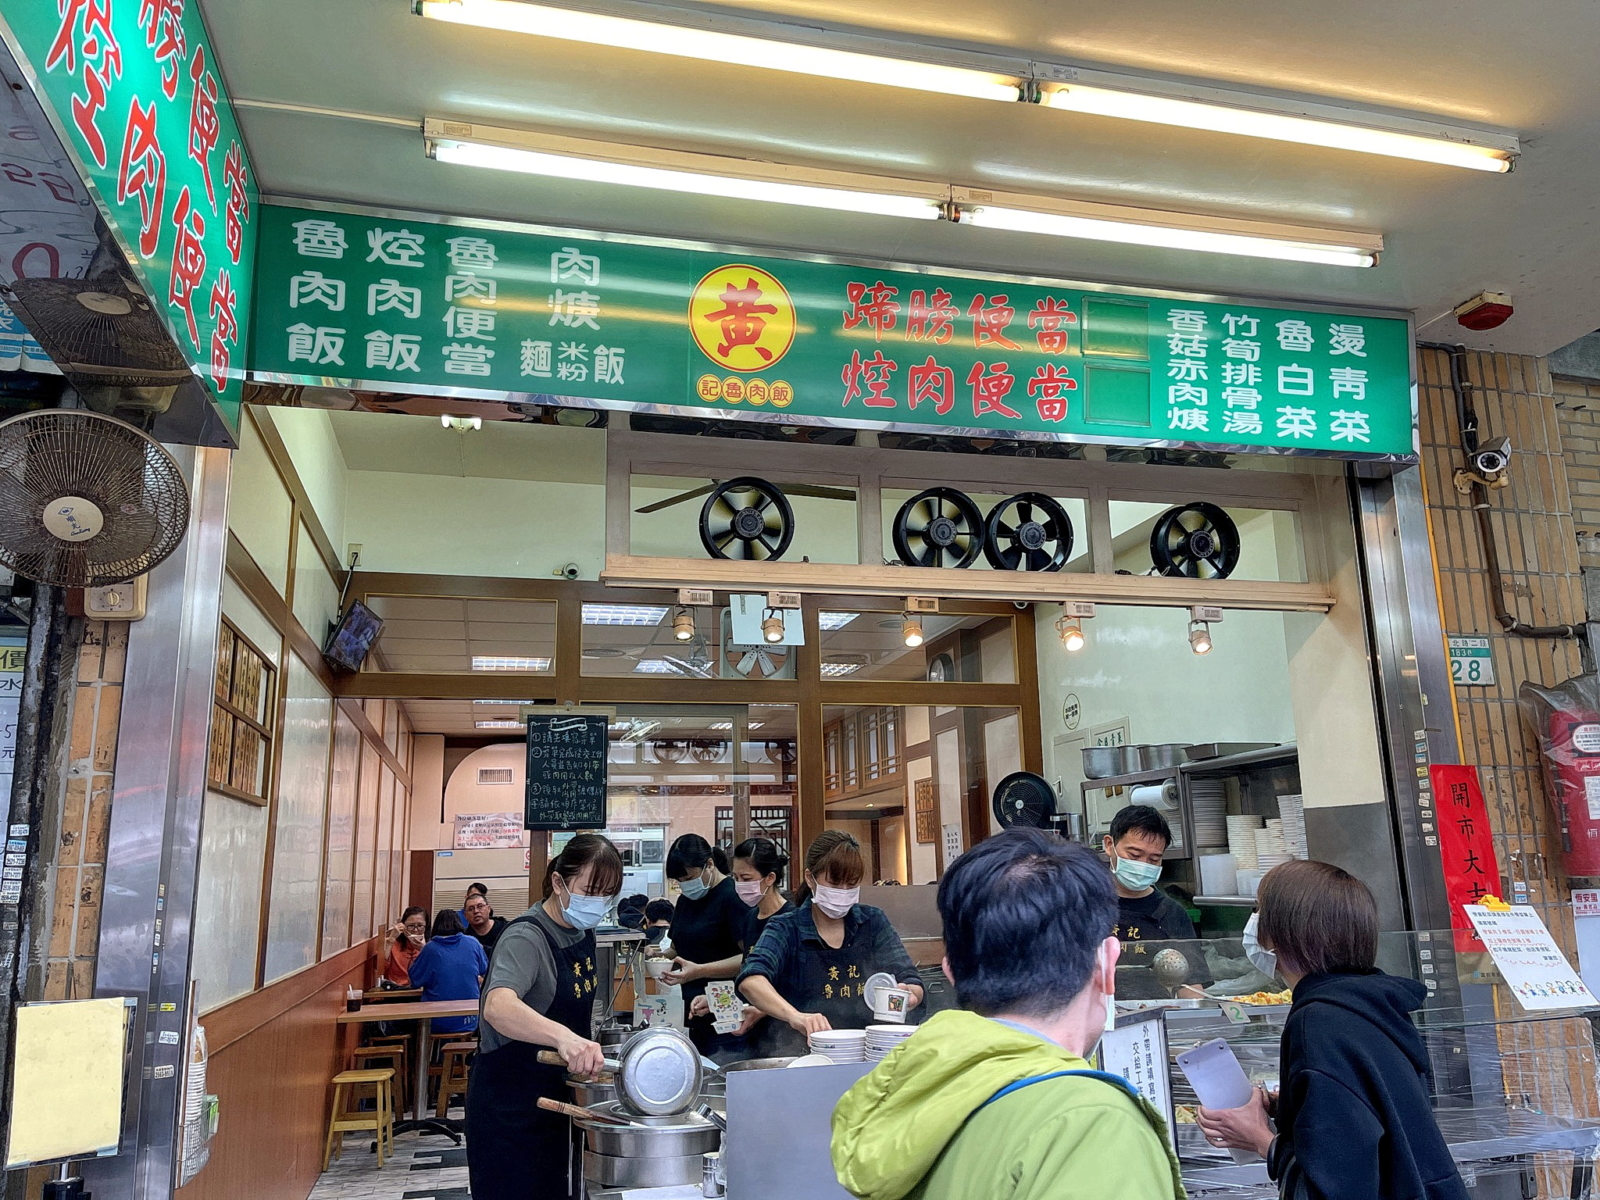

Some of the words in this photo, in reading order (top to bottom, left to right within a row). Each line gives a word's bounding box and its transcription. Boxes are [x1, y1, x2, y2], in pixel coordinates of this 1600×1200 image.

[286, 219, 349, 366] 魯肉飯
[364, 227, 425, 372] 焢肉飯
[441, 236, 499, 377] 魯肉便當
[704, 277, 778, 361] 黃
[842, 280, 1078, 356] 蹄膀便當
[520, 338, 552, 378] 麵
[557, 341, 589, 382] 米粉
[593, 344, 626, 385] 飯
[701, 379, 789, 402] 記魯肉飯
[840, 349, 1078, 423] 焢肉便當
[1221, 312, 1263, 435] 竹筍排骨湯
[1275, 319, 1317, 439] 魯白菜
[1329, 322, 1371, 444] 燙青菜
[1451, 660, 1481, 682] 28
[828, 965, 860, 980] 黃記
[1230, 1006, 1244, 1020] 2
